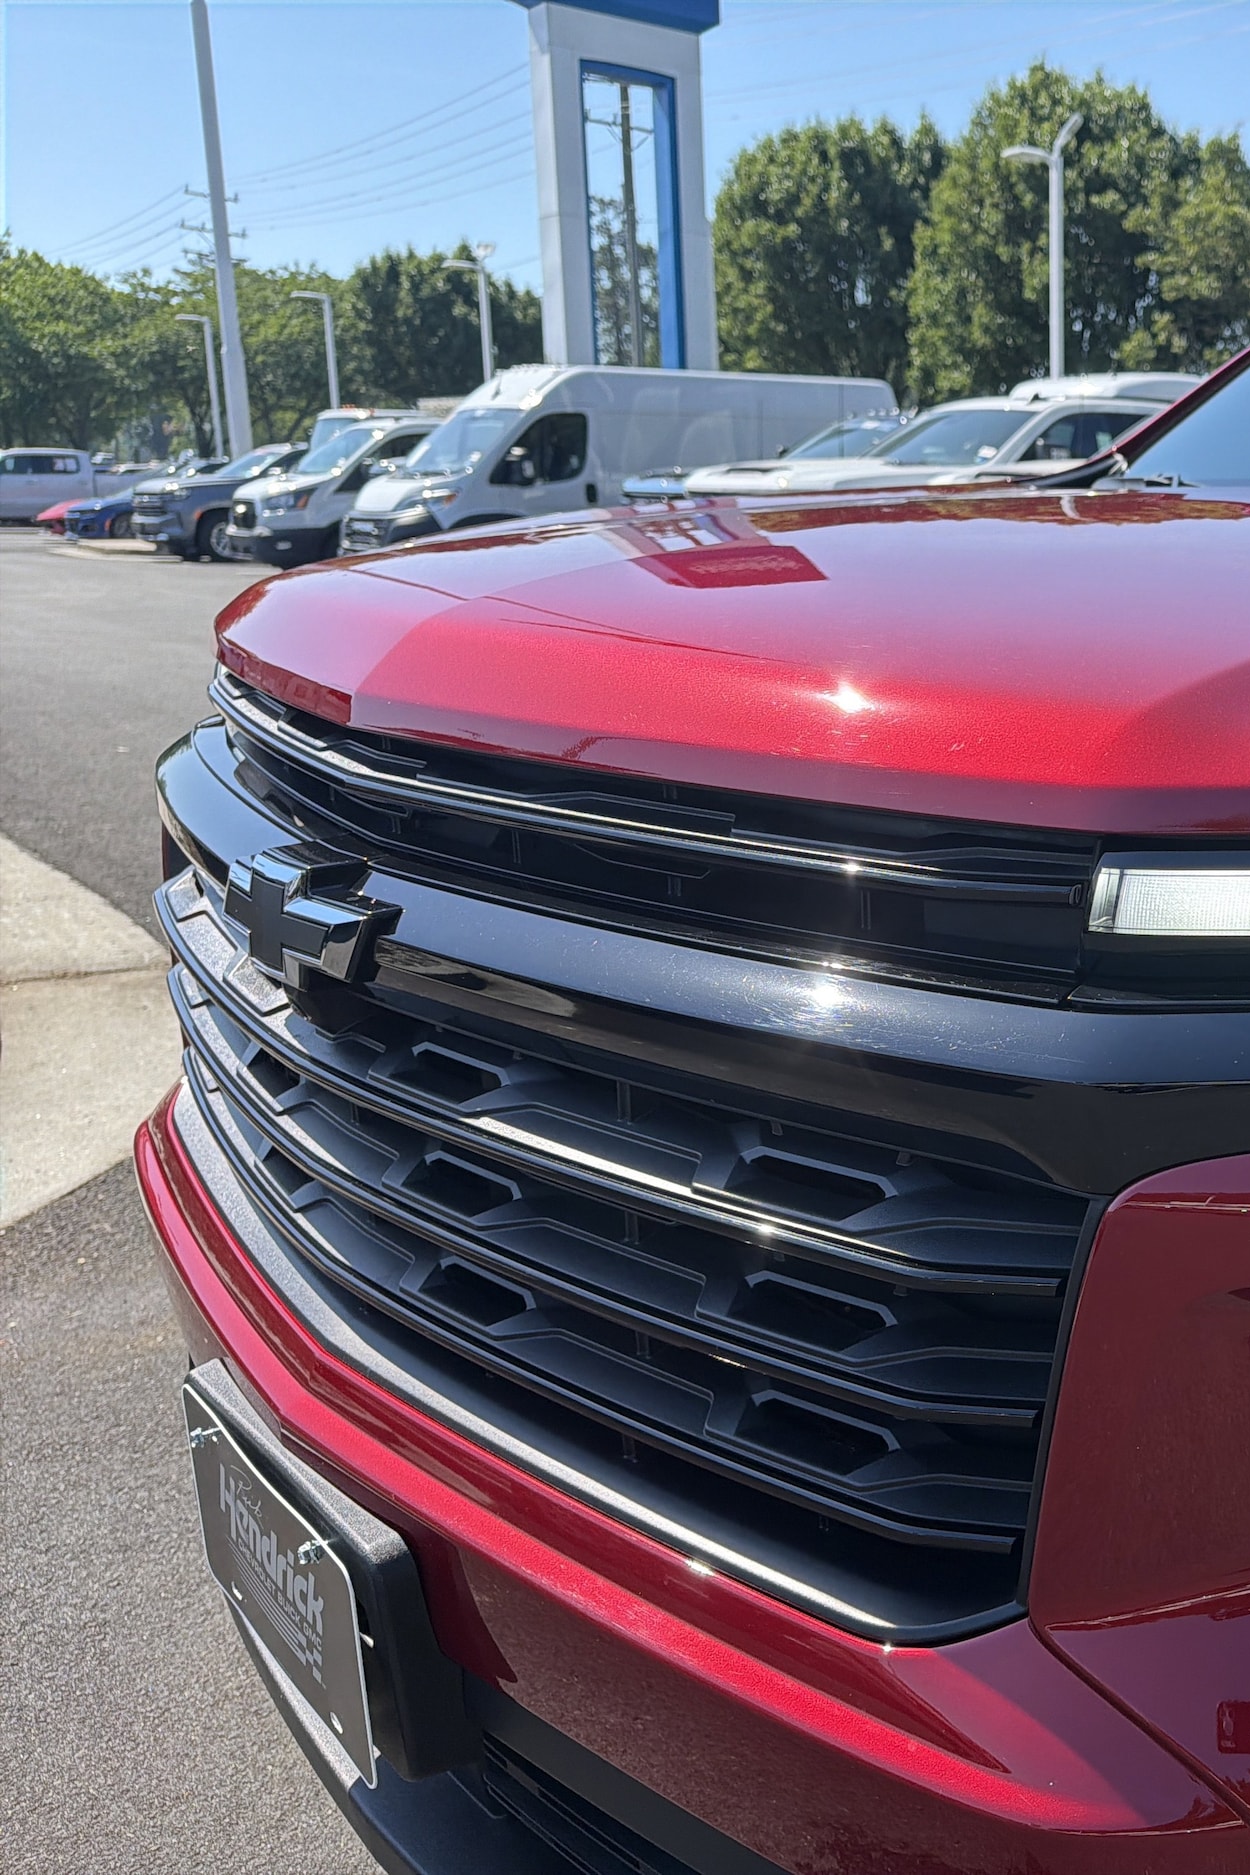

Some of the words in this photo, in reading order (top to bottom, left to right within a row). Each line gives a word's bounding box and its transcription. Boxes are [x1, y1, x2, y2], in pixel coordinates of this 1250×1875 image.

[219, 1463, 325, 1636] Hendrick
[237, 1538, 277, 1596] CHEVROLET
[277, 1591, 301, 1627] BUICK
[303, 1622, 323, 1650] GMC
